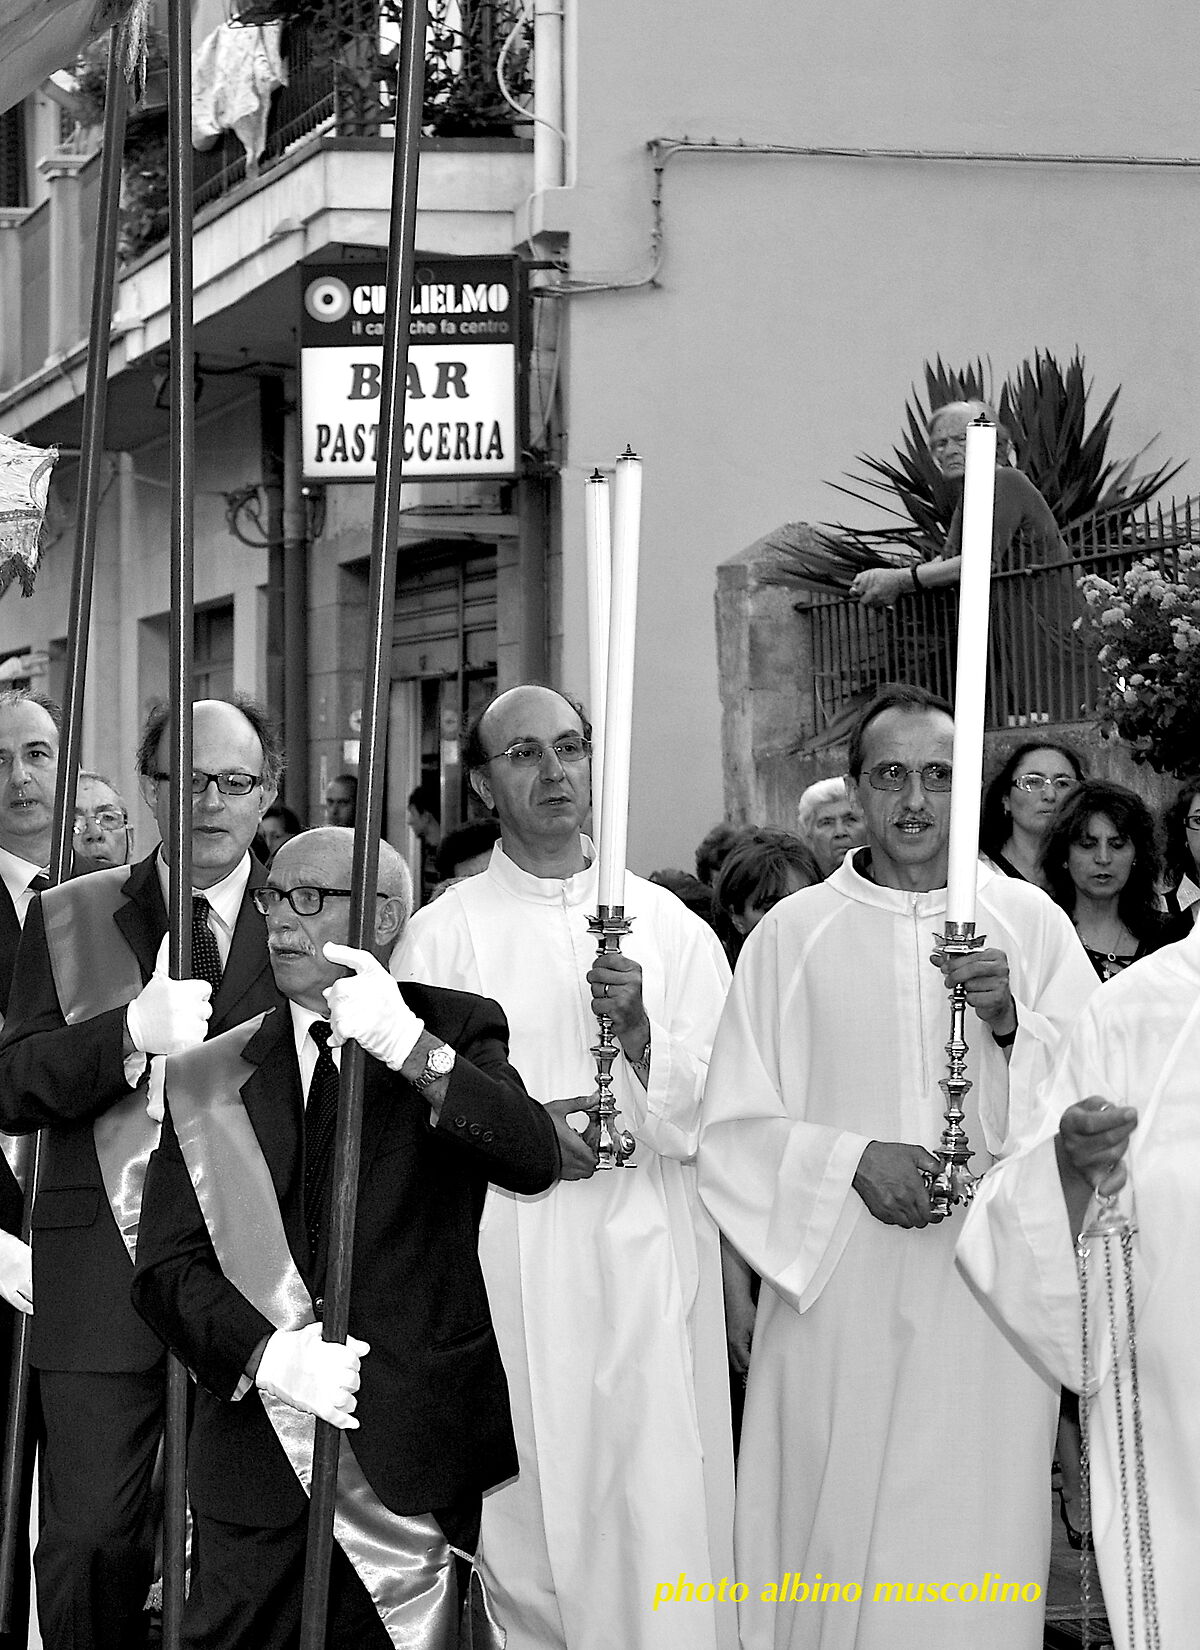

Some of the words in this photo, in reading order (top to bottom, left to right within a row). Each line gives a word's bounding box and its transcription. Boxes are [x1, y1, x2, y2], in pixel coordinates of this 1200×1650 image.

[352, 283, 510, 316] GULIELMO
[351, 320, 363, 336] il
[409, 319, 437, 336] che
[440, 319, 457, 335] fa
[460, 319, 510, 335] centro
[314, 420, 505, 463] PASTCCERIA
